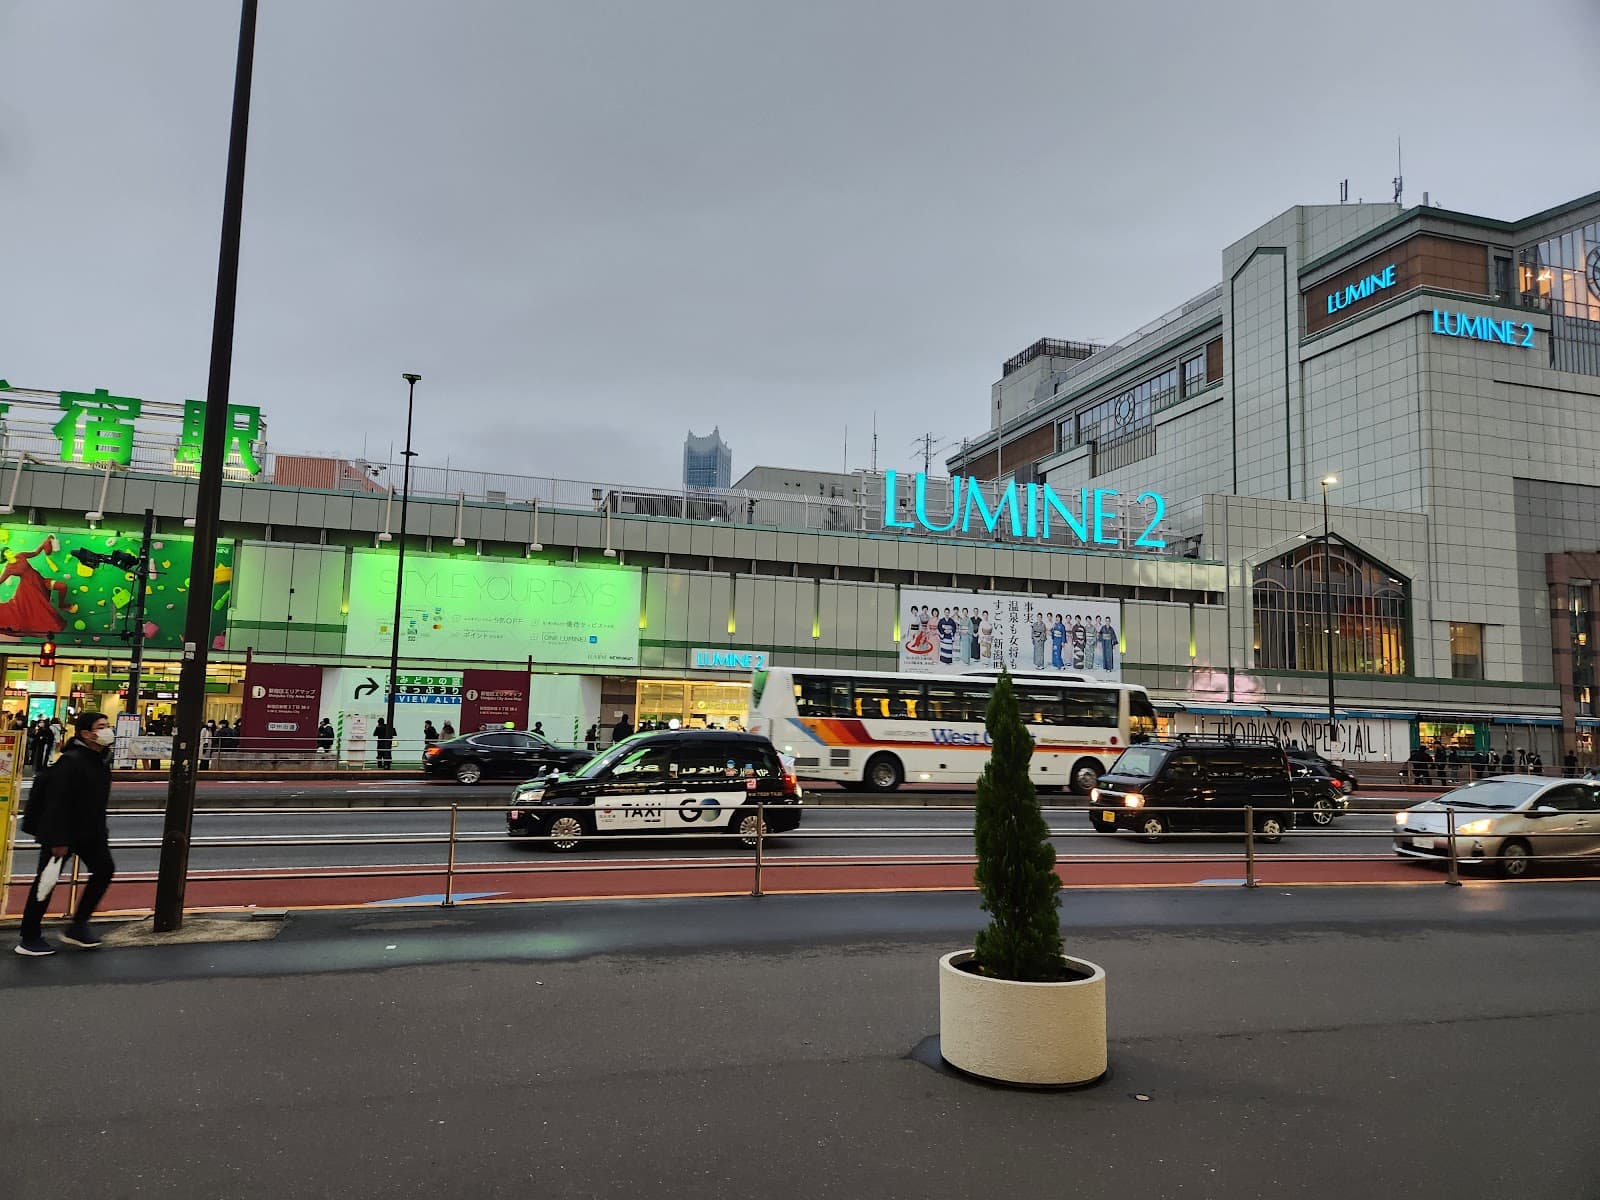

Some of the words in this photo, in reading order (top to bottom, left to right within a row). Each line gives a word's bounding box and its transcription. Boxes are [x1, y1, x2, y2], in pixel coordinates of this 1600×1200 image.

[1327, 263, 1397, 314] LUMINE
[1432, 308, 1516, 346] LUMINE
[1520, 322, 1535, 348] 2
[884, 469, 1119, 545] LUMINE
[1134, 491, 1167, 548] 2
[377, 568, 466, 600] STYLE
[473, 575, 546, 603] YOUR
[552, 578, 617, 608] DAYS
[697, 651, 753, 668] LUMINE
[755, 655, 765, 669] 2
[399, 695, 429, 703] VIEW
[930, 728, 981, 746] West
[1301, 720, 1378, 755] SPECIAL
[621, 802, 662, 819] TAXI
[678, 798, 721, 823] GO
